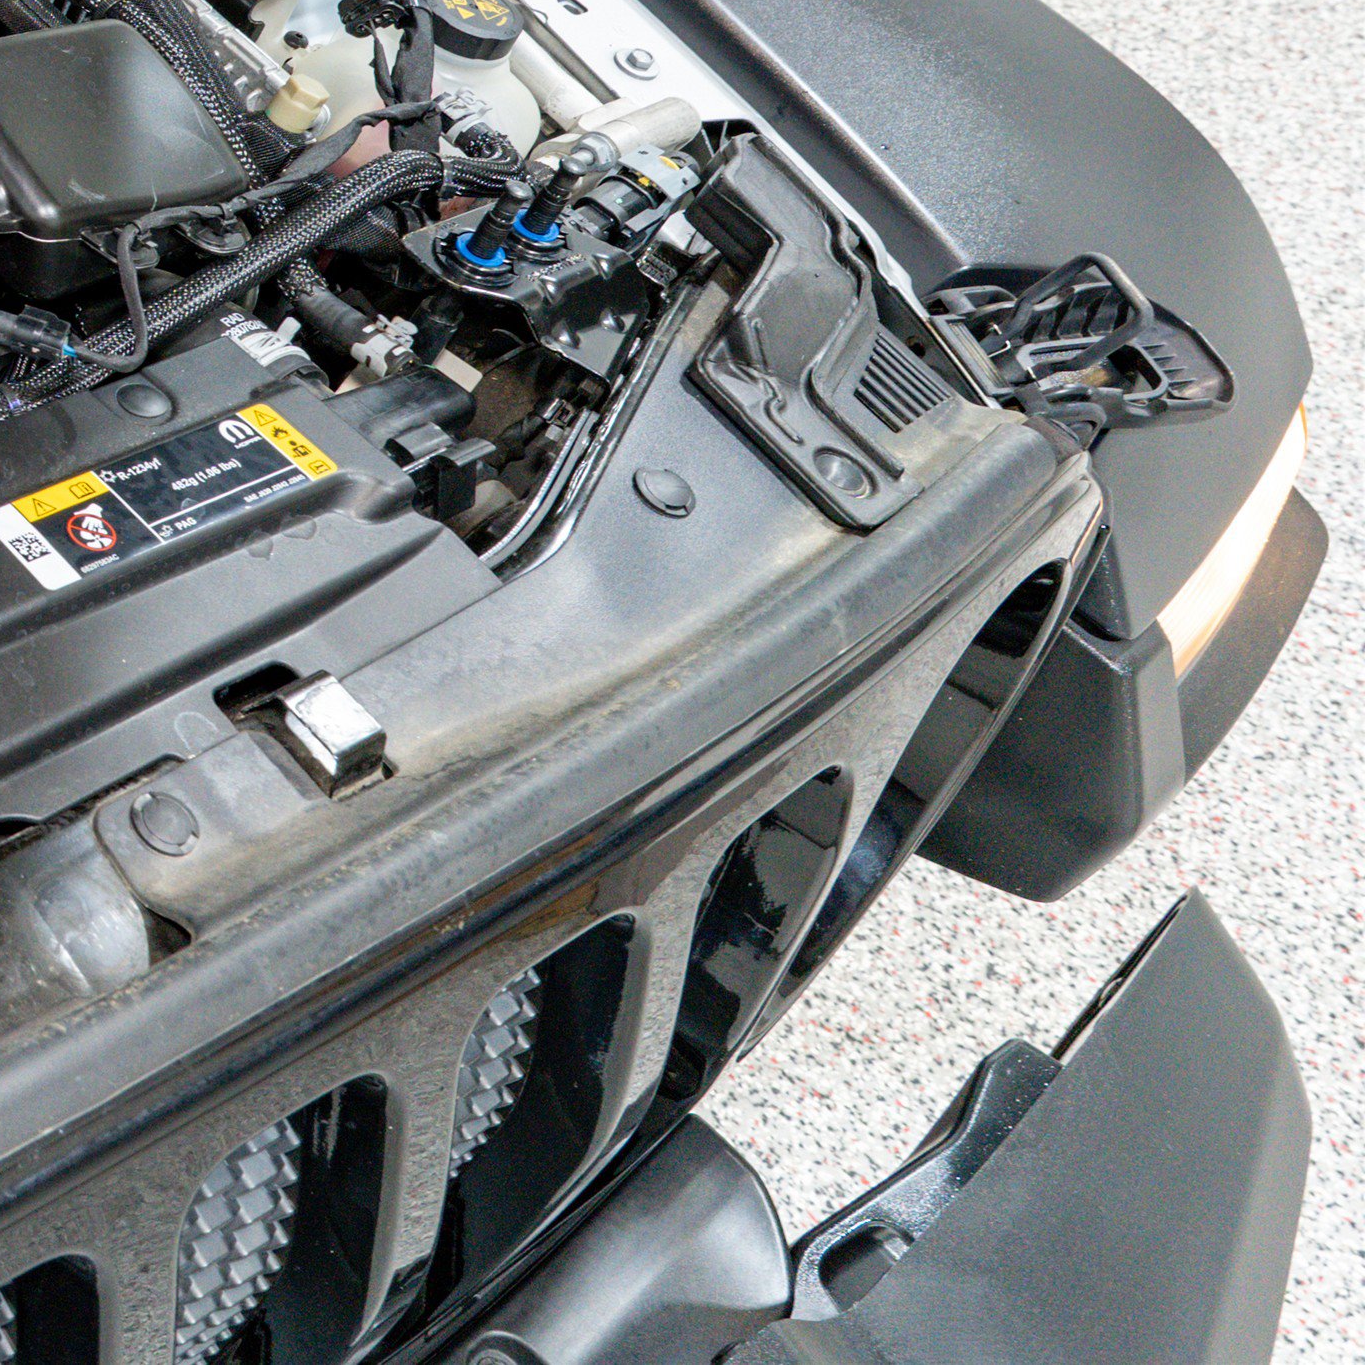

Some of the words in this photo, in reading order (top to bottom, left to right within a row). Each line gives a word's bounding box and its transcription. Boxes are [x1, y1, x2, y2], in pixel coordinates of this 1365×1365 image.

[116, 457, 162, 481] R-1234yf
[171, 477, 199, 491] 482g
[195, 466, 222, 483] (1.06
[218, 458, 242, 472] lbs)
[174, 516, 198, 531] PAG
